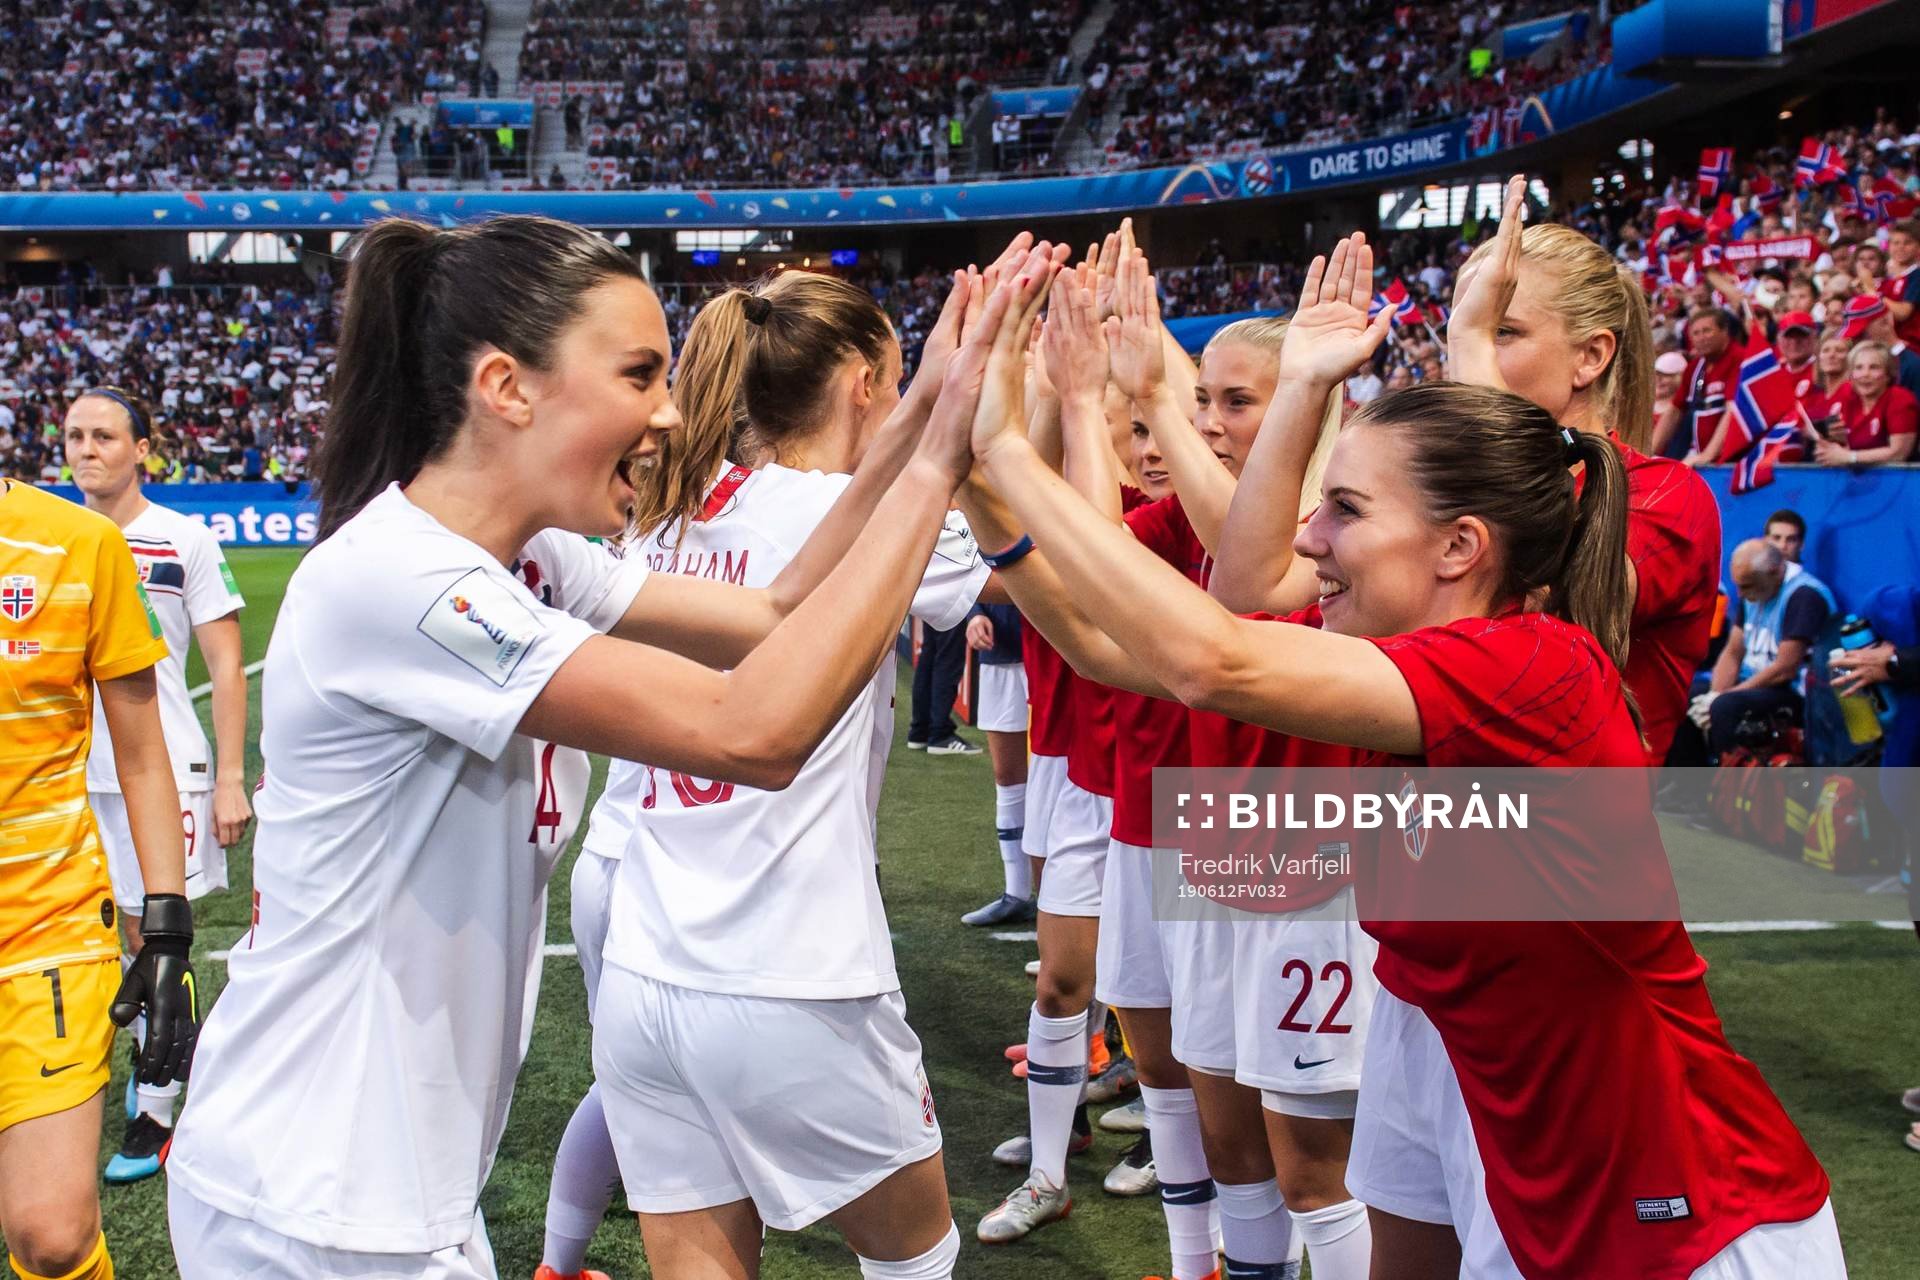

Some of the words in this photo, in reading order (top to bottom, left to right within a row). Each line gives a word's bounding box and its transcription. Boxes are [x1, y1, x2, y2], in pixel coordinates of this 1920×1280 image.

[1310, 150, 1360, 180] DARE
[1364, 145, 1389, 171] TO
[1391, 133, 1446, 166] SHINE
[187, 506, 320, 542] ates
[42, 967, 66, 1038] 1
[1277, 959, 1353, 1034] 22
